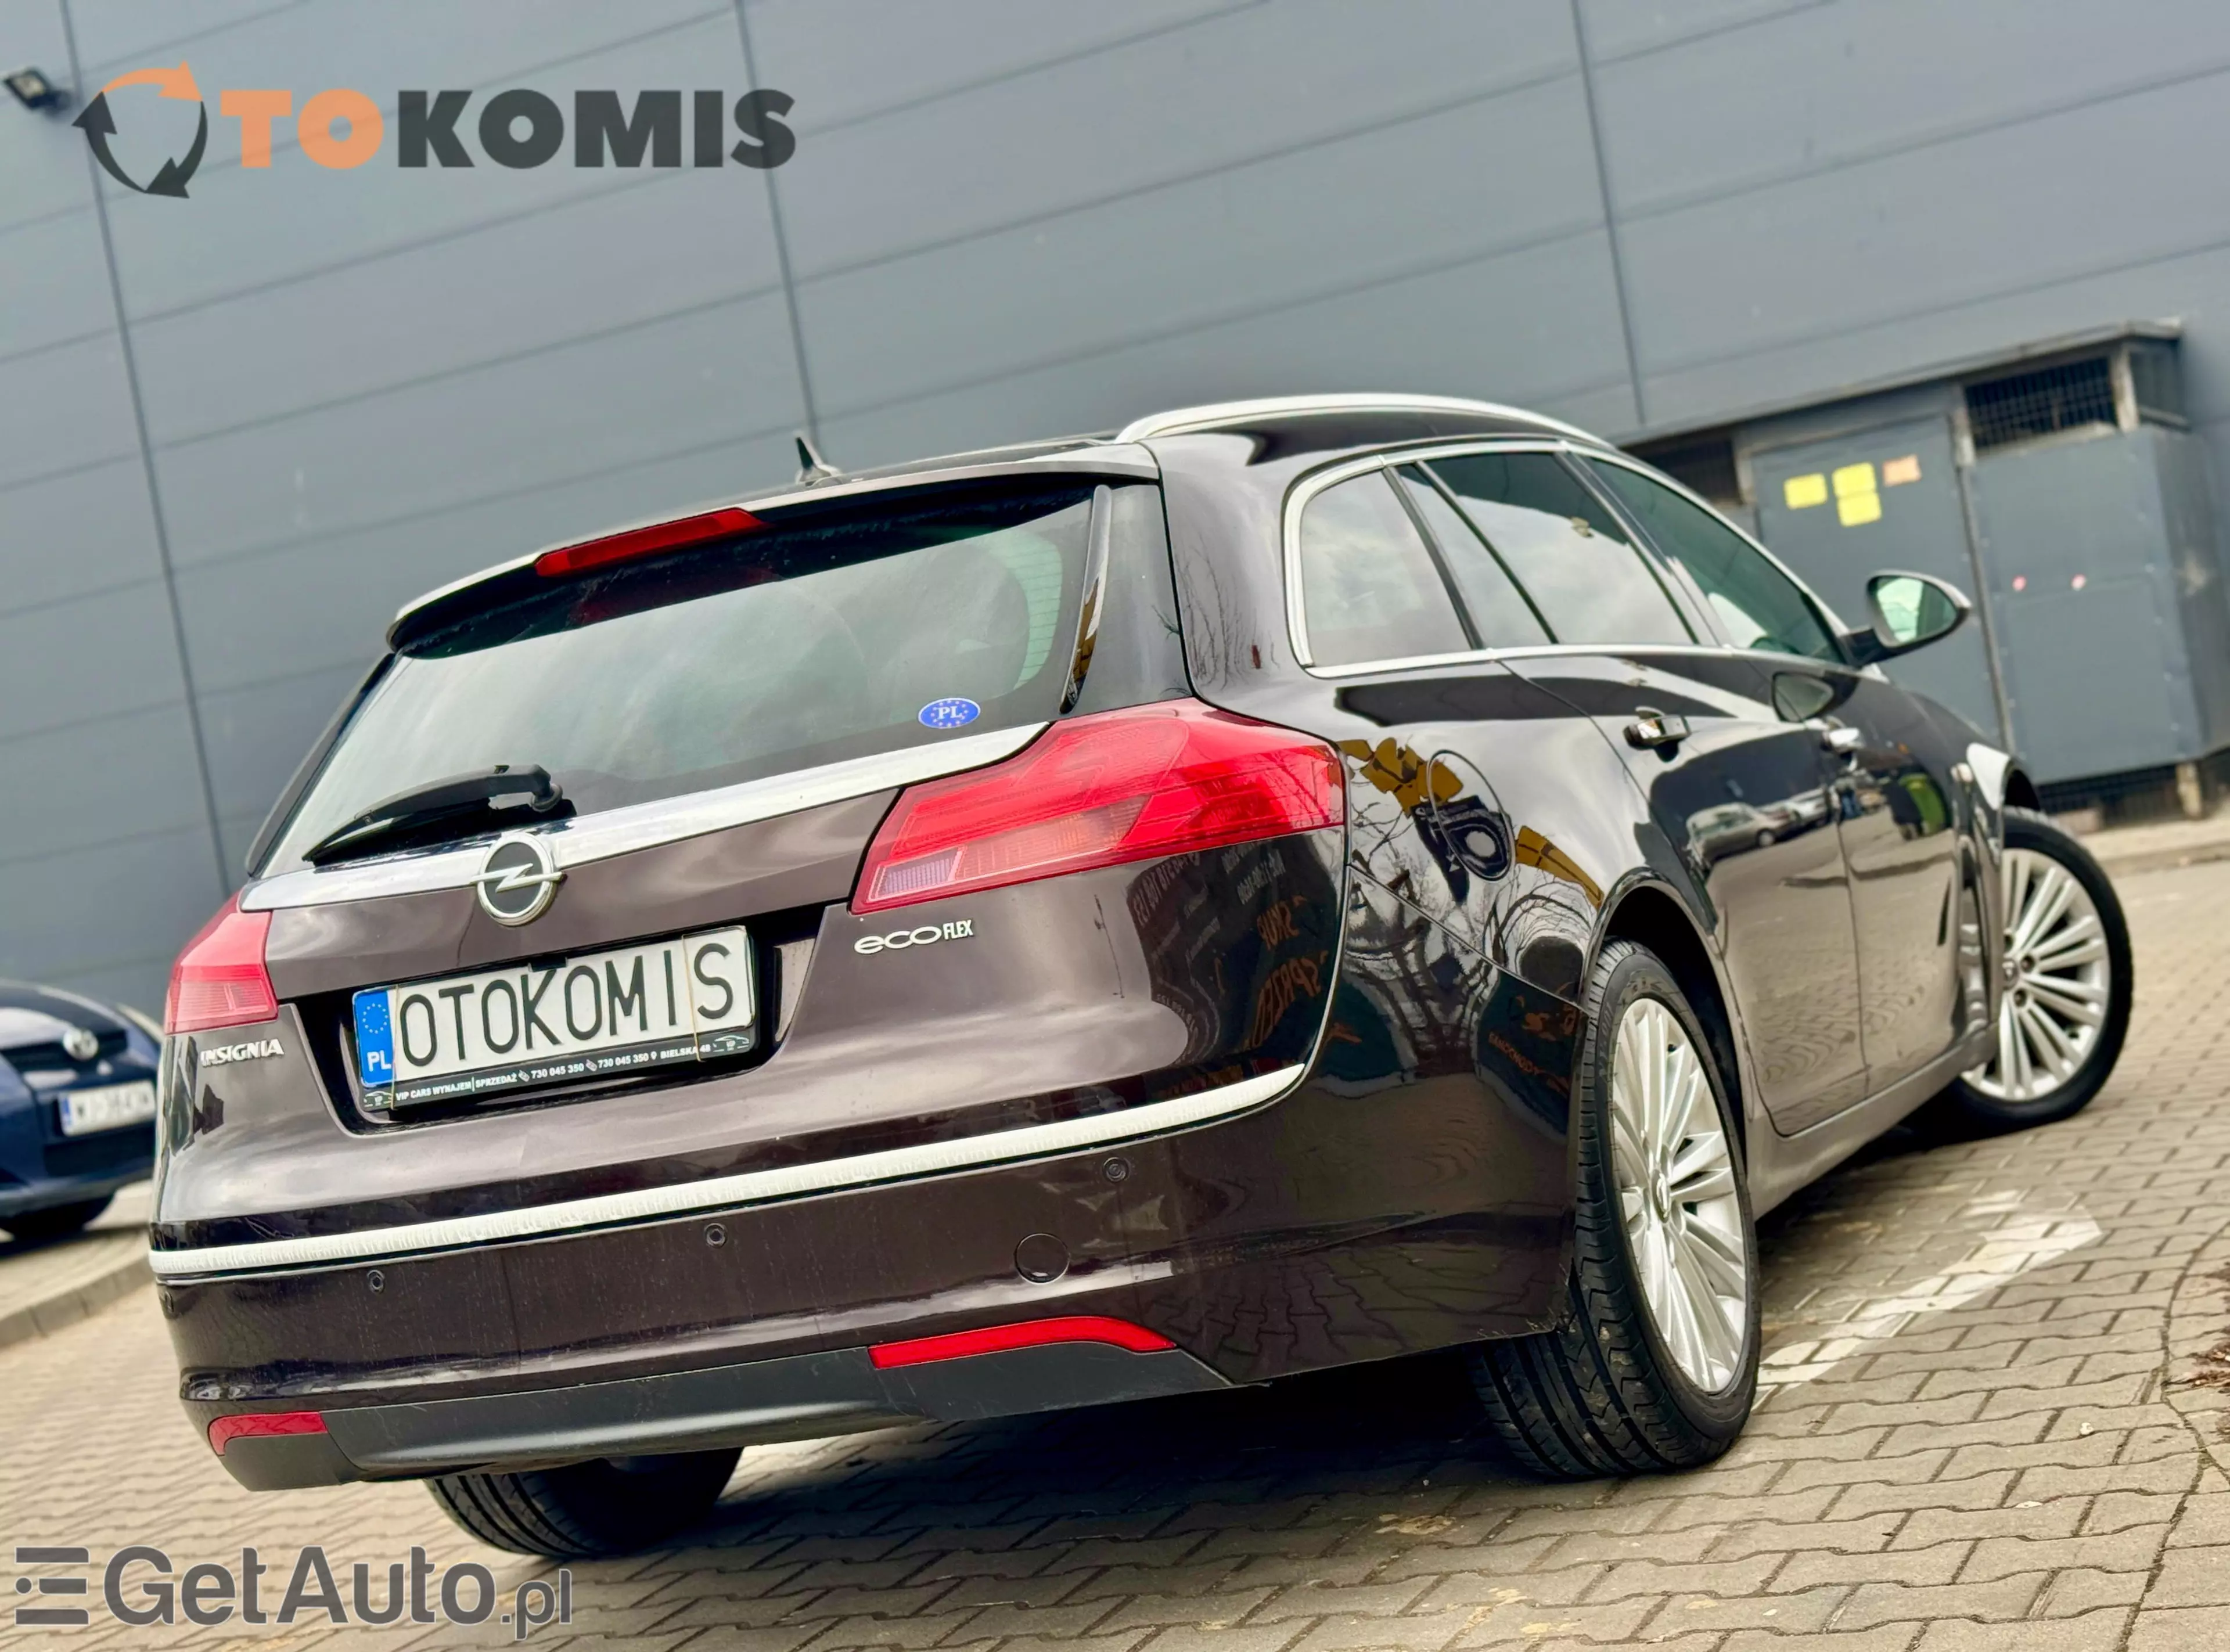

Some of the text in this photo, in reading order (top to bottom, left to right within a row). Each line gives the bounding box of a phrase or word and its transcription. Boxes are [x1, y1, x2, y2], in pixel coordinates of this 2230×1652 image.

[937, 706, 962, 719] PL
[400, 943, 734, 1067] OTOKOMIS
[200, 1038, 285, 1067] INSIGNIA
[368, 1050, 391, 1072] PL
[395, 1092, 409, 1101] VIP
[410, 1089, 431, 1099] CARS
[530, 1068, 548, 1079] 730
[549, 1066, 566, 1076] 045
[568, 1063, 585, 1073] 350
[598, 1059, 614, 1068] 730
[616, 1056, 631, 1066] 045
[633, 1053, 649, 1063] 350
[660, 1046, 697, 1059] BIELSKA
